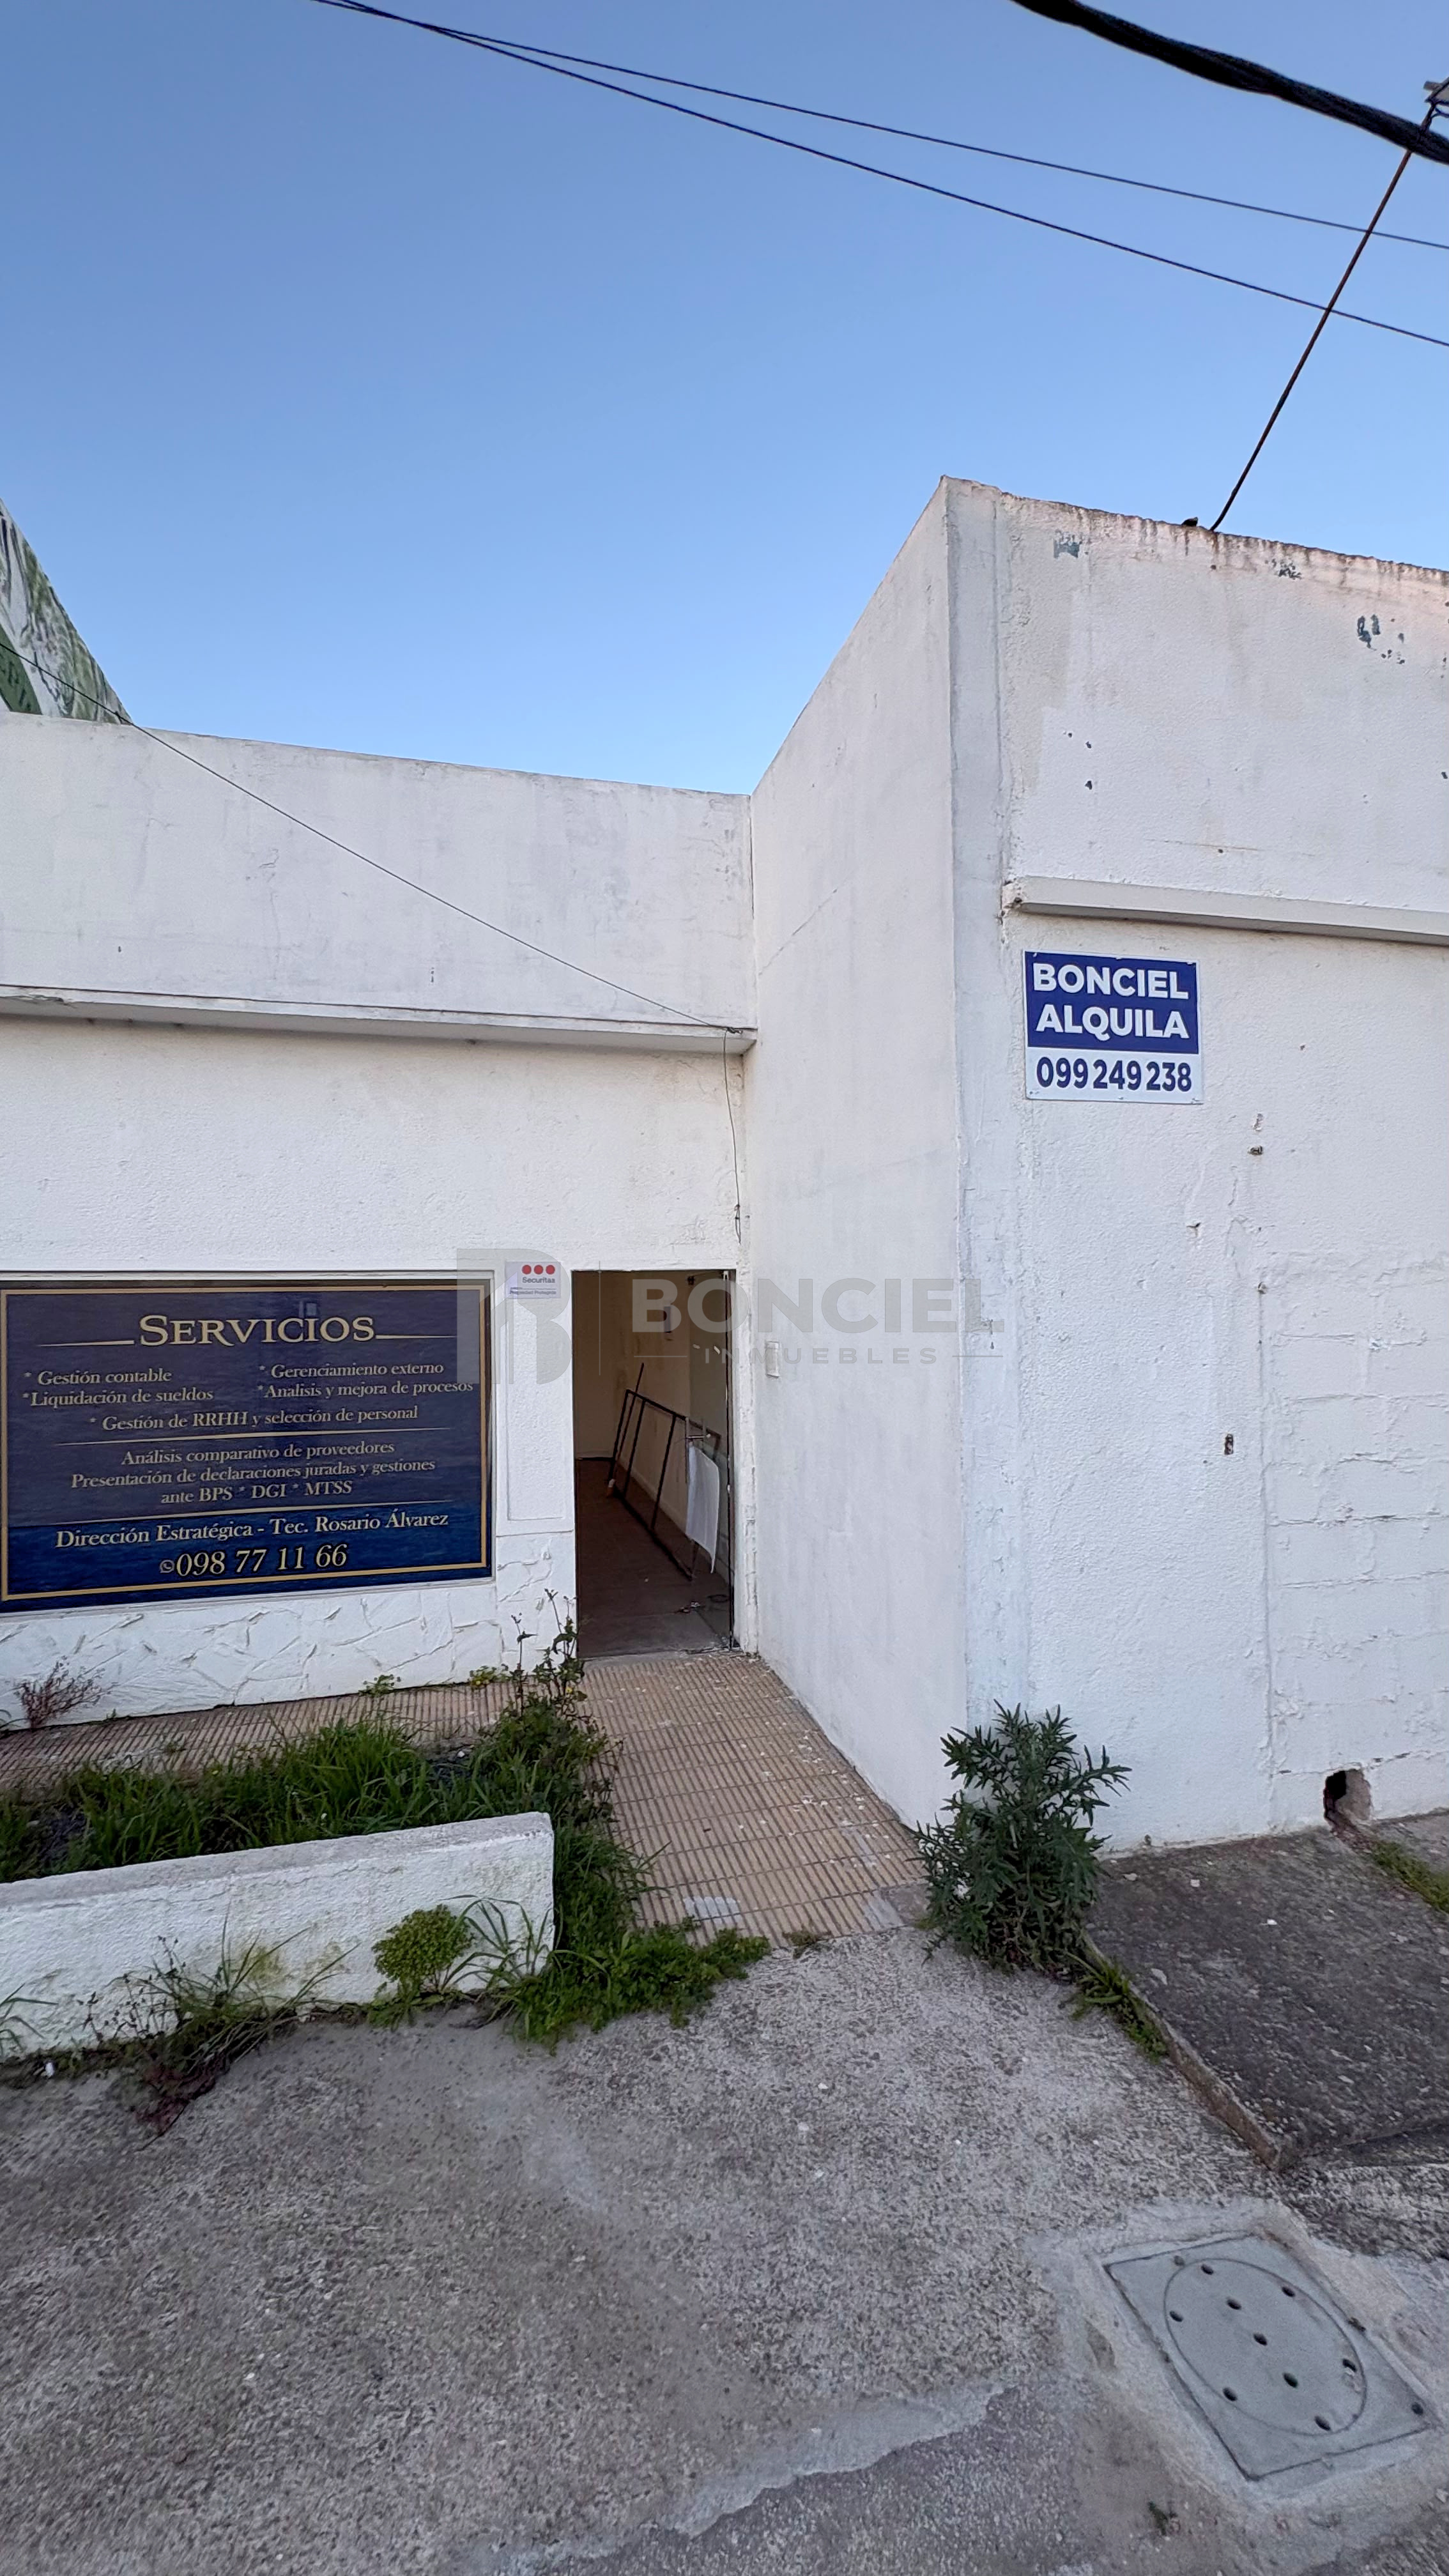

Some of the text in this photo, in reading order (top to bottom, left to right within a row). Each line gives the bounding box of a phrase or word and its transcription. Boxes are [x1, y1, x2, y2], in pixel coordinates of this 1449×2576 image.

[1032, 962, 1189, 1000] BONCIEL
[1035, 1004, 1190, 1041] ALQUILA
[139, 1315, 375, 1346] SERVICIOS
[38, 1368, 172, 1386] Gestión contable
[271, 1361, 444, 1379] Gerenciamiento externo
[31, 1387, 213, 1410] Liquidación de sueldos
[325, 1386, 334, 1399] y
[338, 1381, 388, 1398] mejora
[391, 1380, 409, 1394] de
[412, 1382, 473, 1397] procesos
[102, 1405, 418, 1430] Gestión de RRHH y selección de personal
[121, 1441, 395, 1465] Análisis comparativo de proveedores
[71, 1458, 436, 1488] Presentación de declaraciones juradas y gestiones
[161, 1480, 353, 1503] ante BPS DGI MTSS
[55, 1508, 449, 1548] Dirección Estratégica Tec. Rosario Álvarez
[176, 1544, 348, 1577] 098 77 11 66
